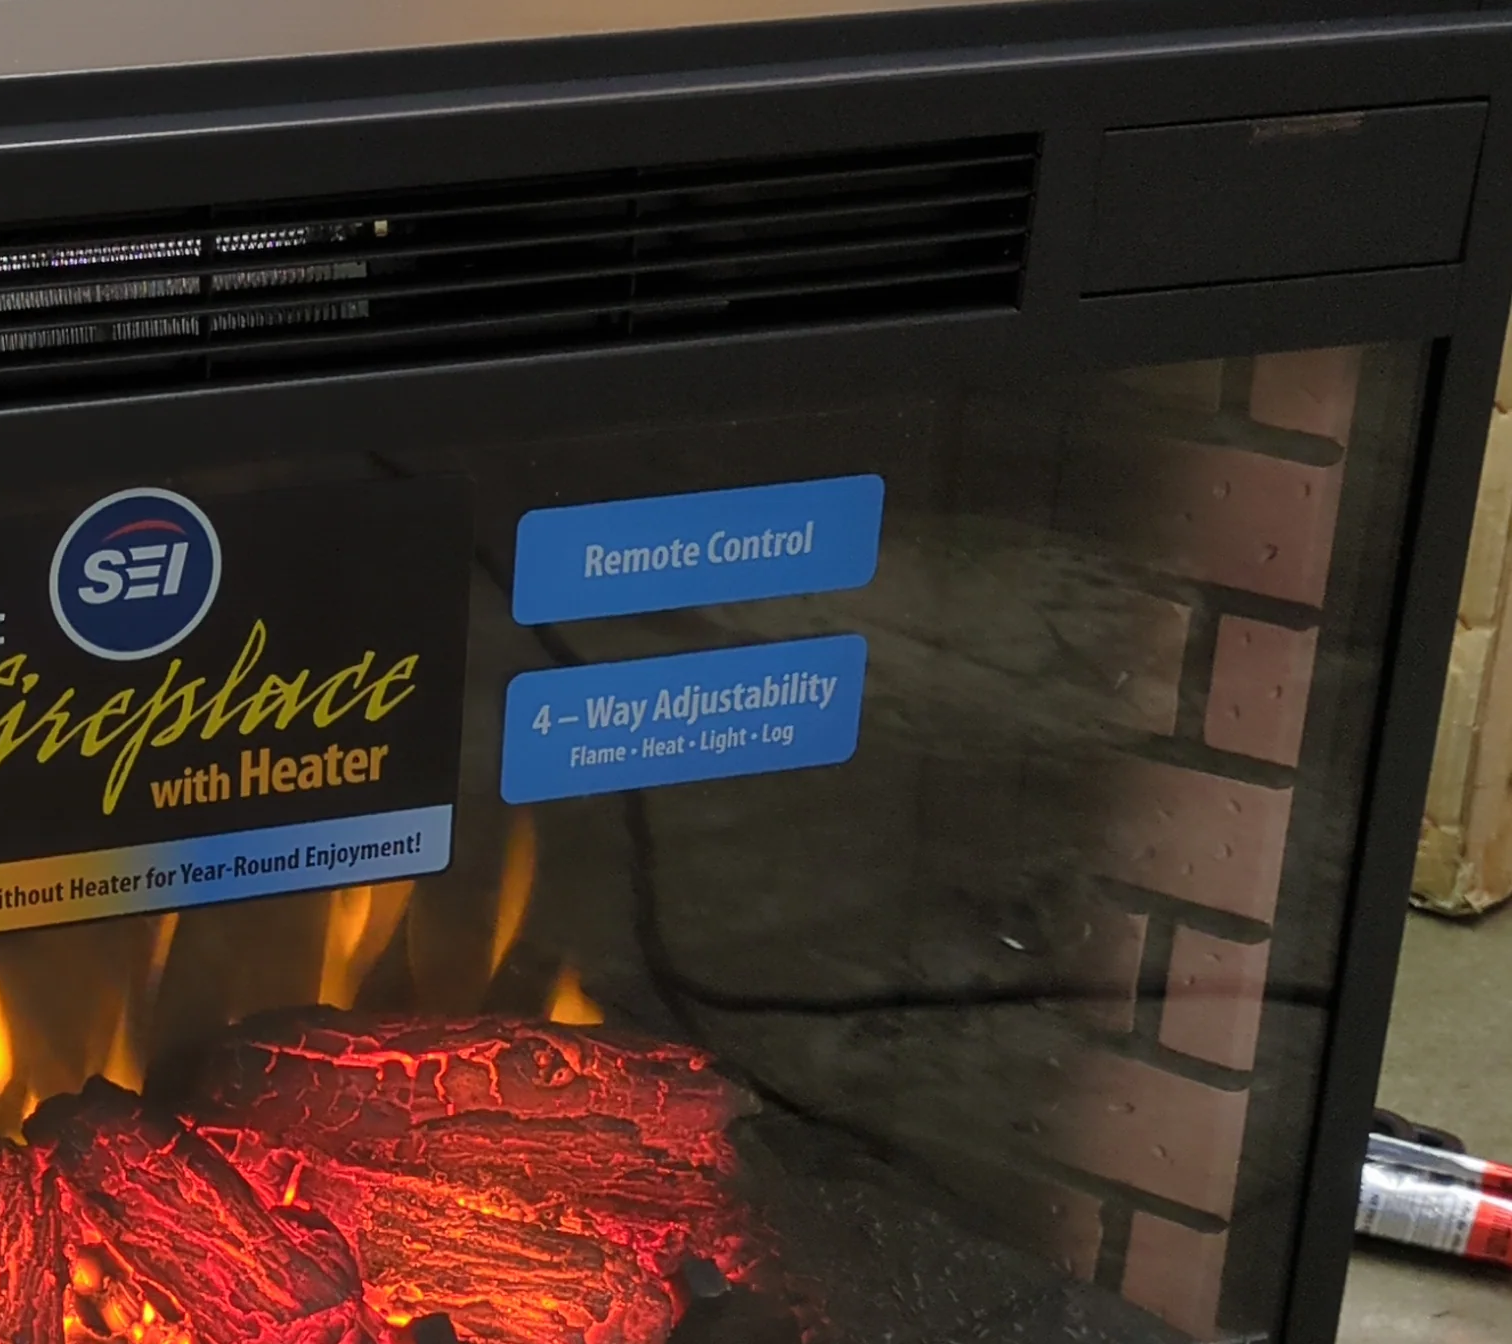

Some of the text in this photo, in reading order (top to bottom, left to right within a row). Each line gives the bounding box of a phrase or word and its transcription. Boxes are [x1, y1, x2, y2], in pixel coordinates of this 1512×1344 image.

[78, 541, 189, 605] SEI
[584, 521, 814, 578] Remote Control
[653, 671, 838, 725] Adjustability
[570, 723, 794, 768] Flame Heat Light Log
[150, 743, 389, 809] with Heater
[69, 874, 141, 900] Heater
[146, 866, 177, 889] for
[180, 848, 300, 885] Year-Round
[305, 832, 422, 871] Enjoyment!
